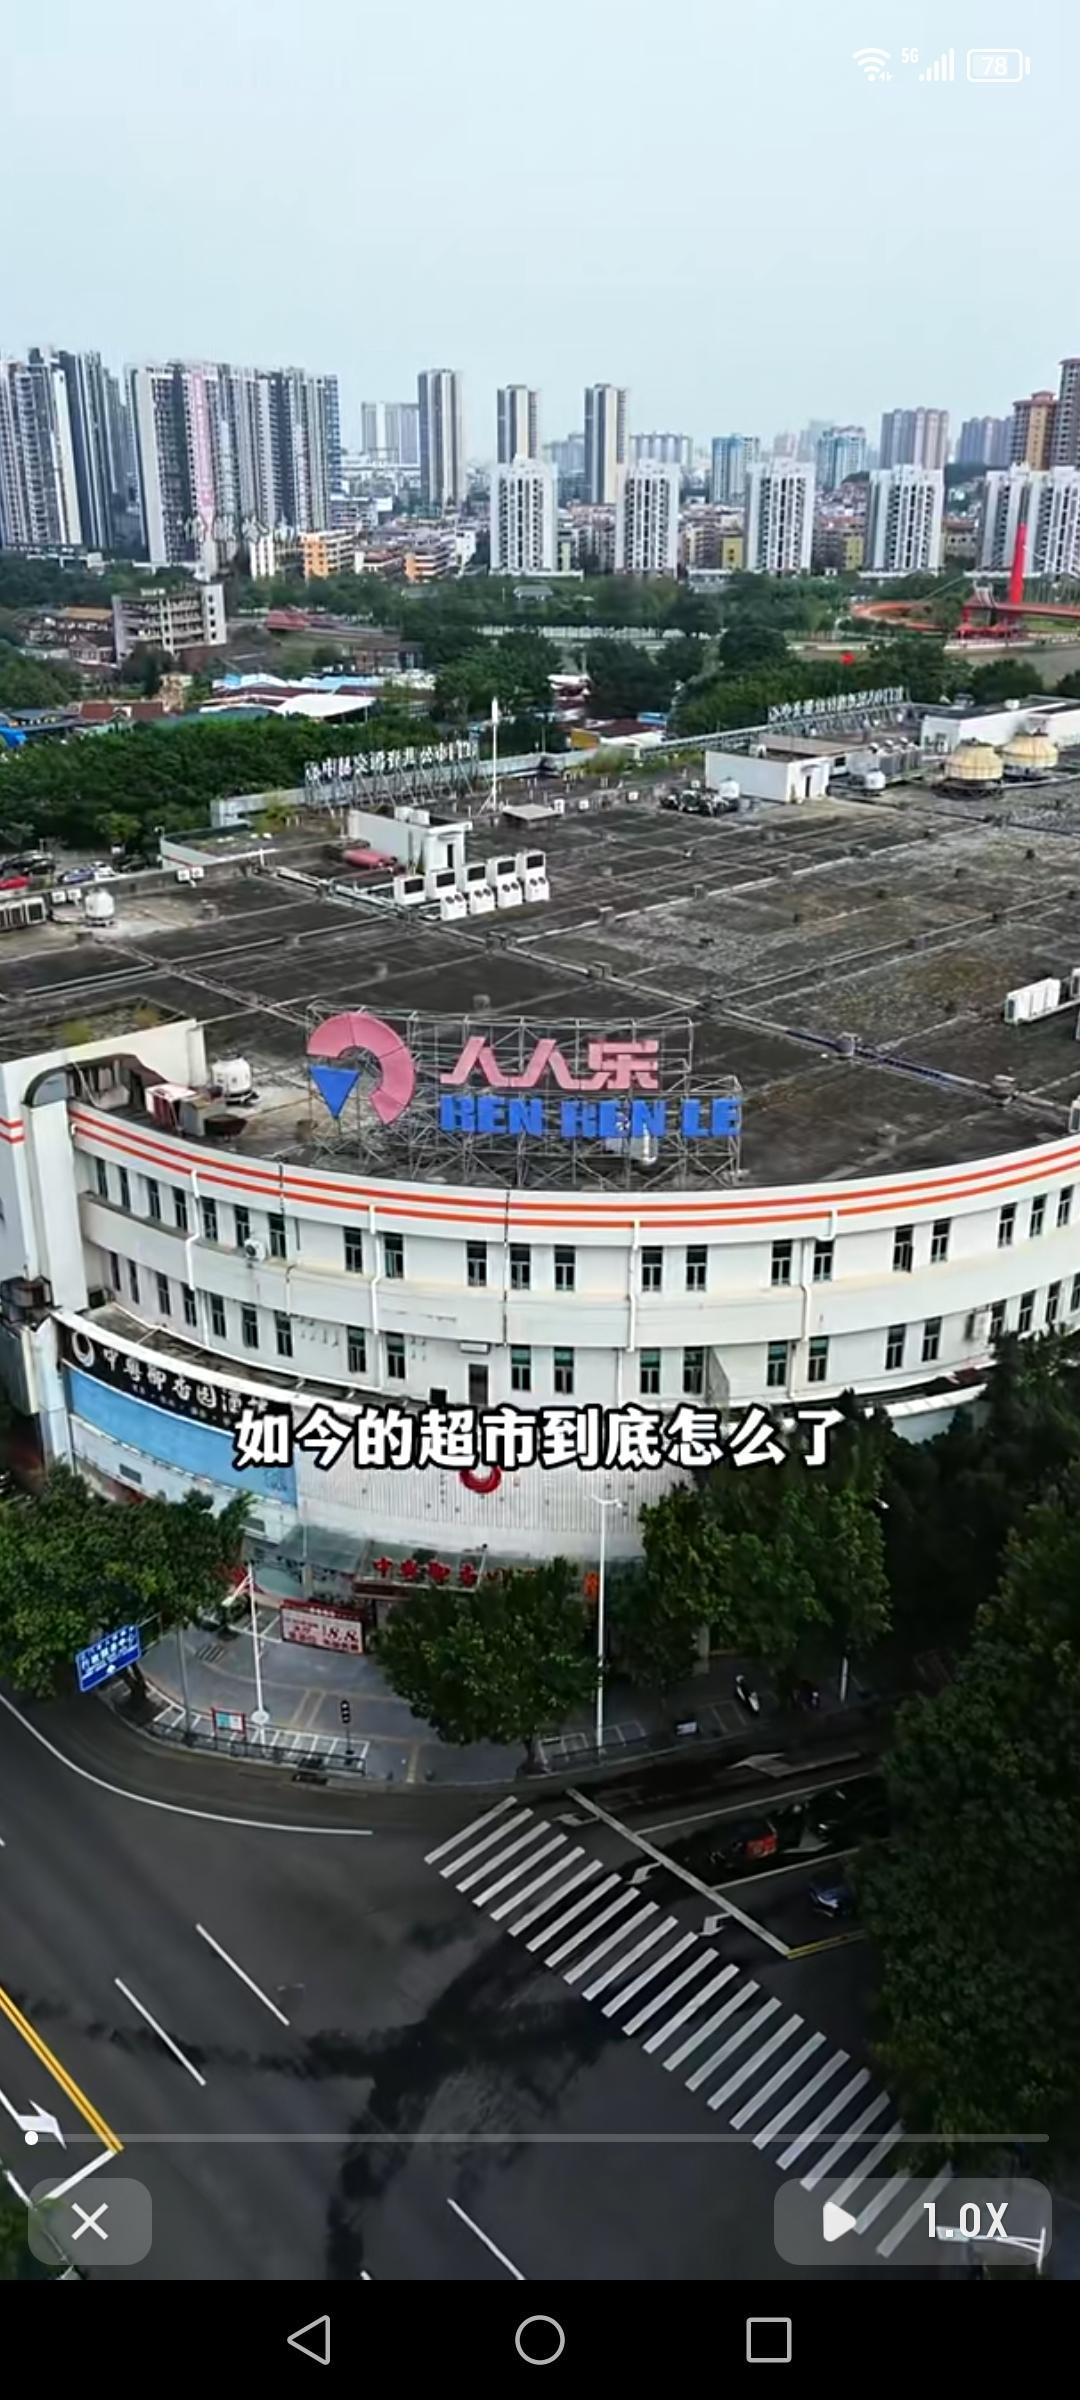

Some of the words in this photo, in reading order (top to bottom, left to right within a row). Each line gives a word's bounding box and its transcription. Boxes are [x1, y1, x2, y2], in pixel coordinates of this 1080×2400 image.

[439, 1036, 659, 1090] 人人乐
[440, 1094, 543, 1136] REN
[682, 1097, 741, 1137] LE
